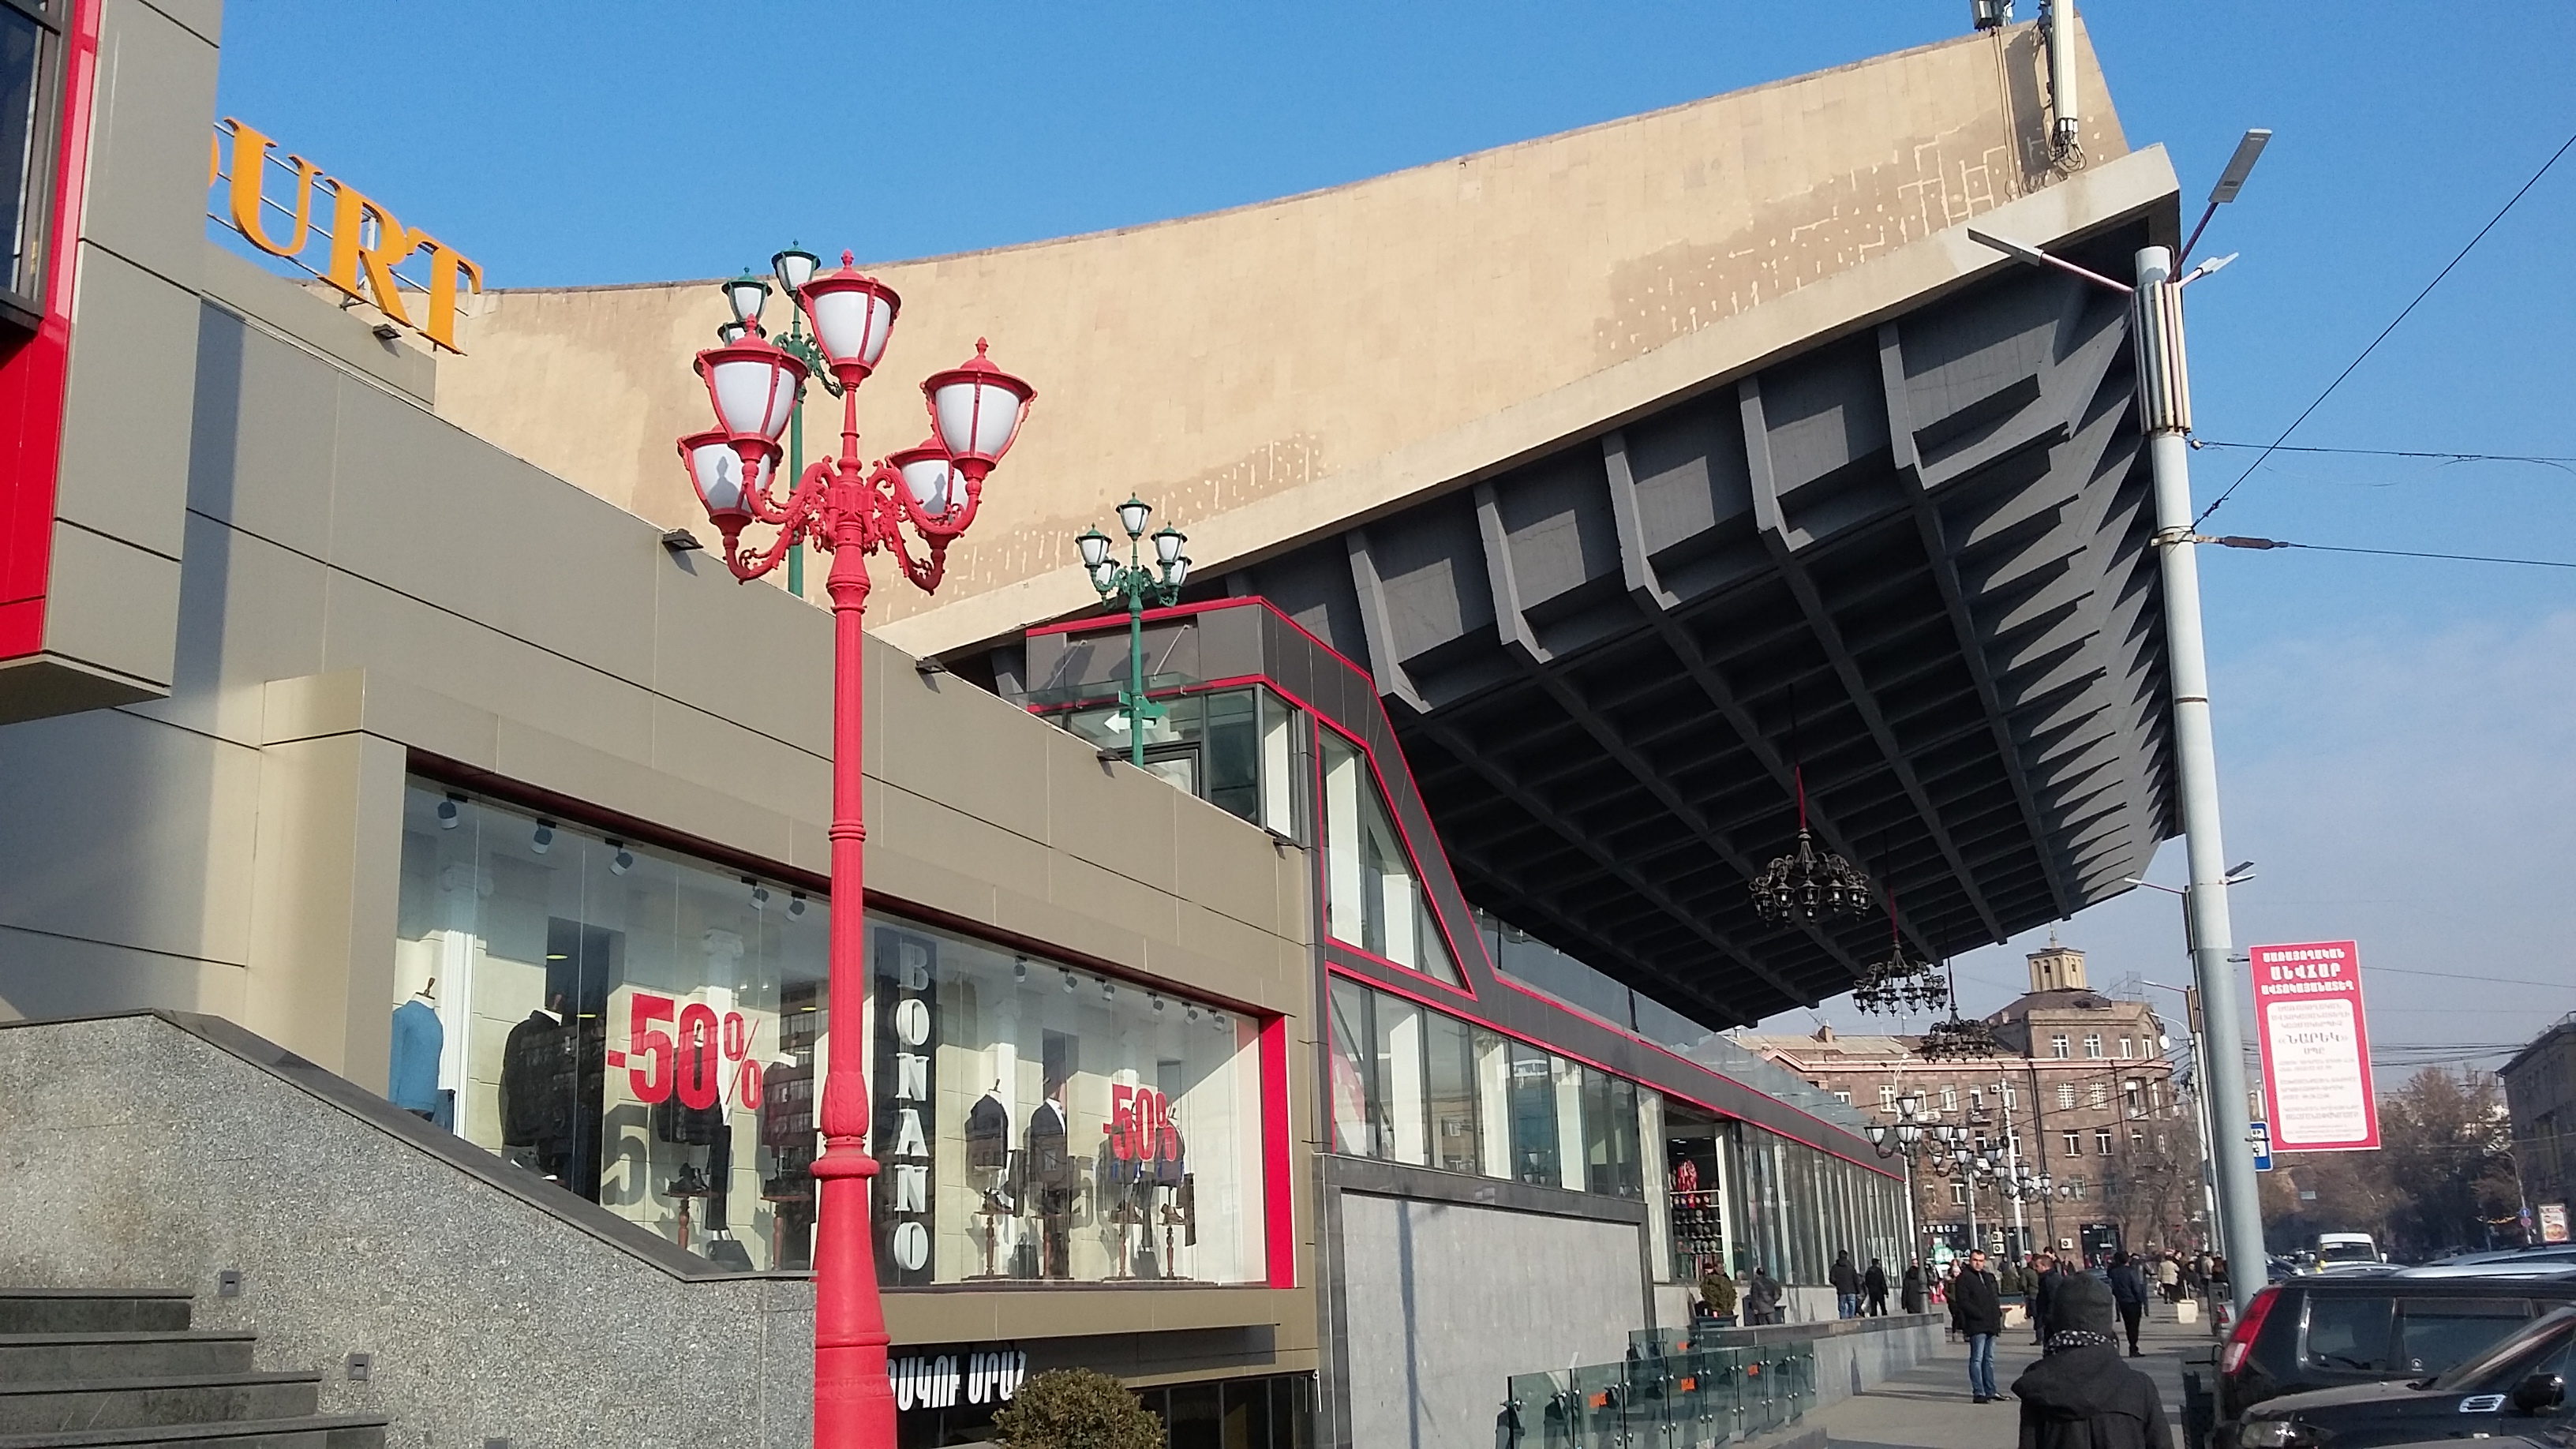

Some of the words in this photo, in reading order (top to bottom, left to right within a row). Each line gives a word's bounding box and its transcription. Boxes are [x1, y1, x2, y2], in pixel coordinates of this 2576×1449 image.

[209, 116, 483, 355] URT
[2270, 962, 2341, 981] ԱՆՎՃԱՐ
[607, 992, 763, 1110] -50%
[893, 943, 930, 1271] BONANO
[1103, 1083, 1177, 1162] -50%
